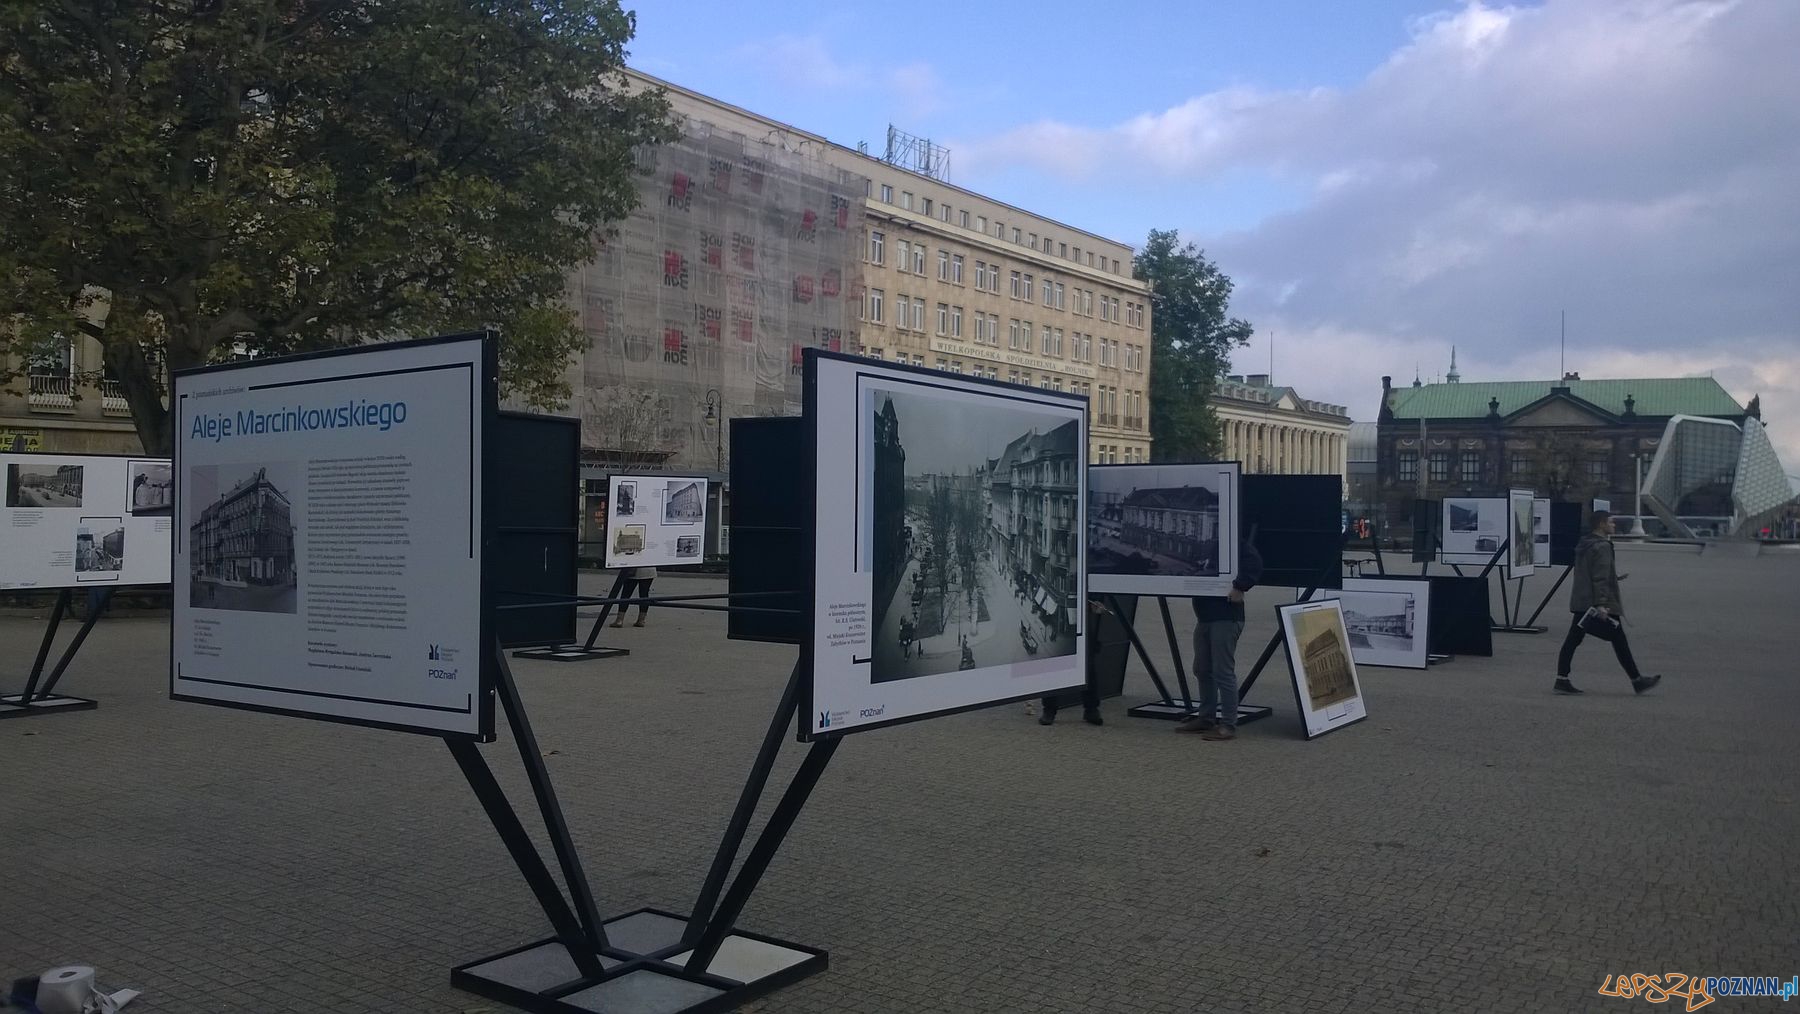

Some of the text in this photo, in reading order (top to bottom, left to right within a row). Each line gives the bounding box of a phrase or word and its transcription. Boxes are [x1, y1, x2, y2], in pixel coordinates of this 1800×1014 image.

[937, 342, 1001, 361] WIELKOPOLSKA
[191, 399, 407, 443] Aleje Marcinkowskiego
